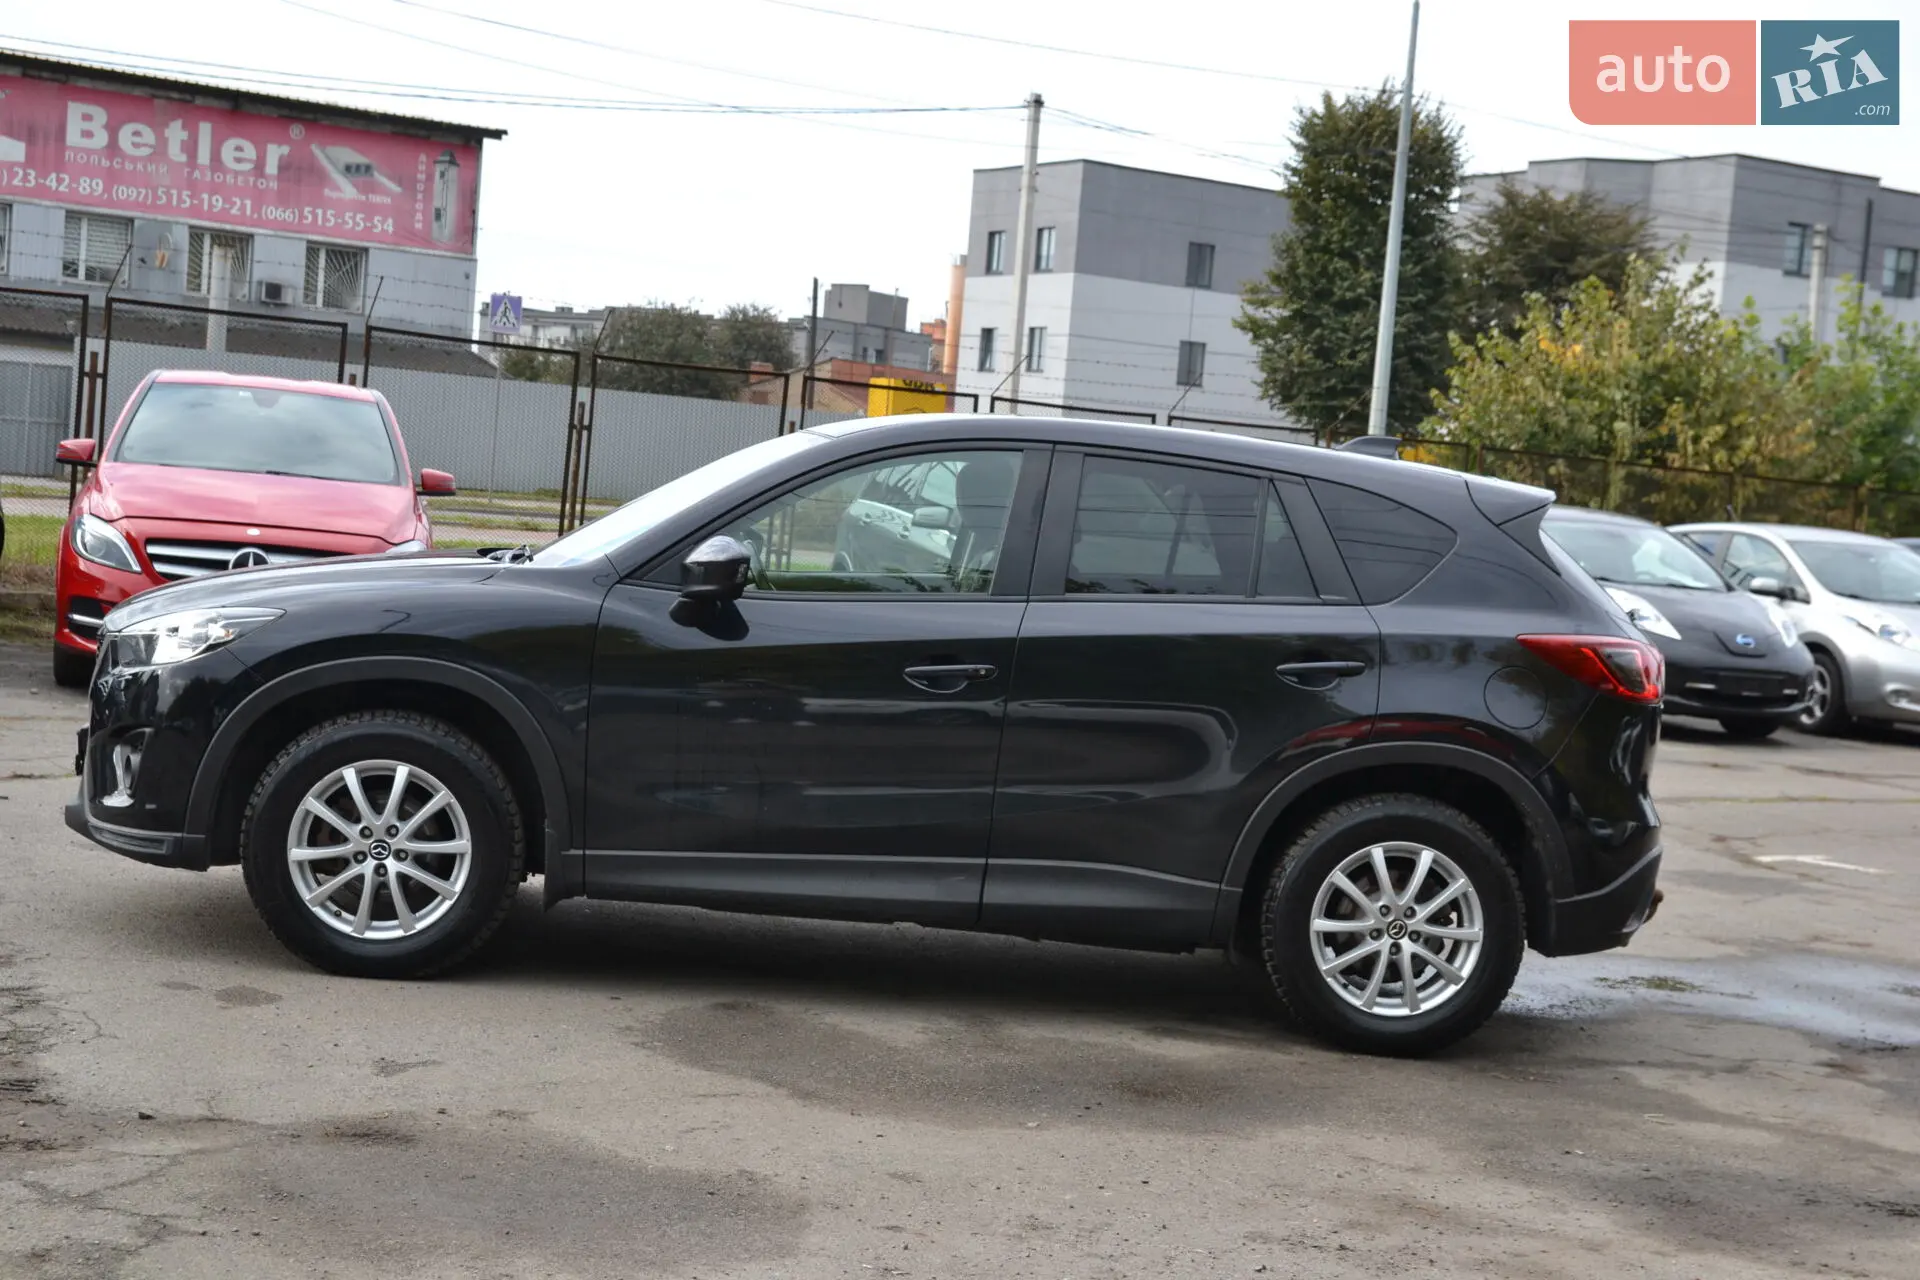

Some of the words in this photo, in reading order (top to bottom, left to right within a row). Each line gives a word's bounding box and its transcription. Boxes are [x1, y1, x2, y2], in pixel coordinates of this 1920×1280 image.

[66, 100, 291, 175] Betler
[112, 184, 152, 204] (097)
[262, 205, 299, 224] (066)
[303, 207, 394, 235] 515-55-54
